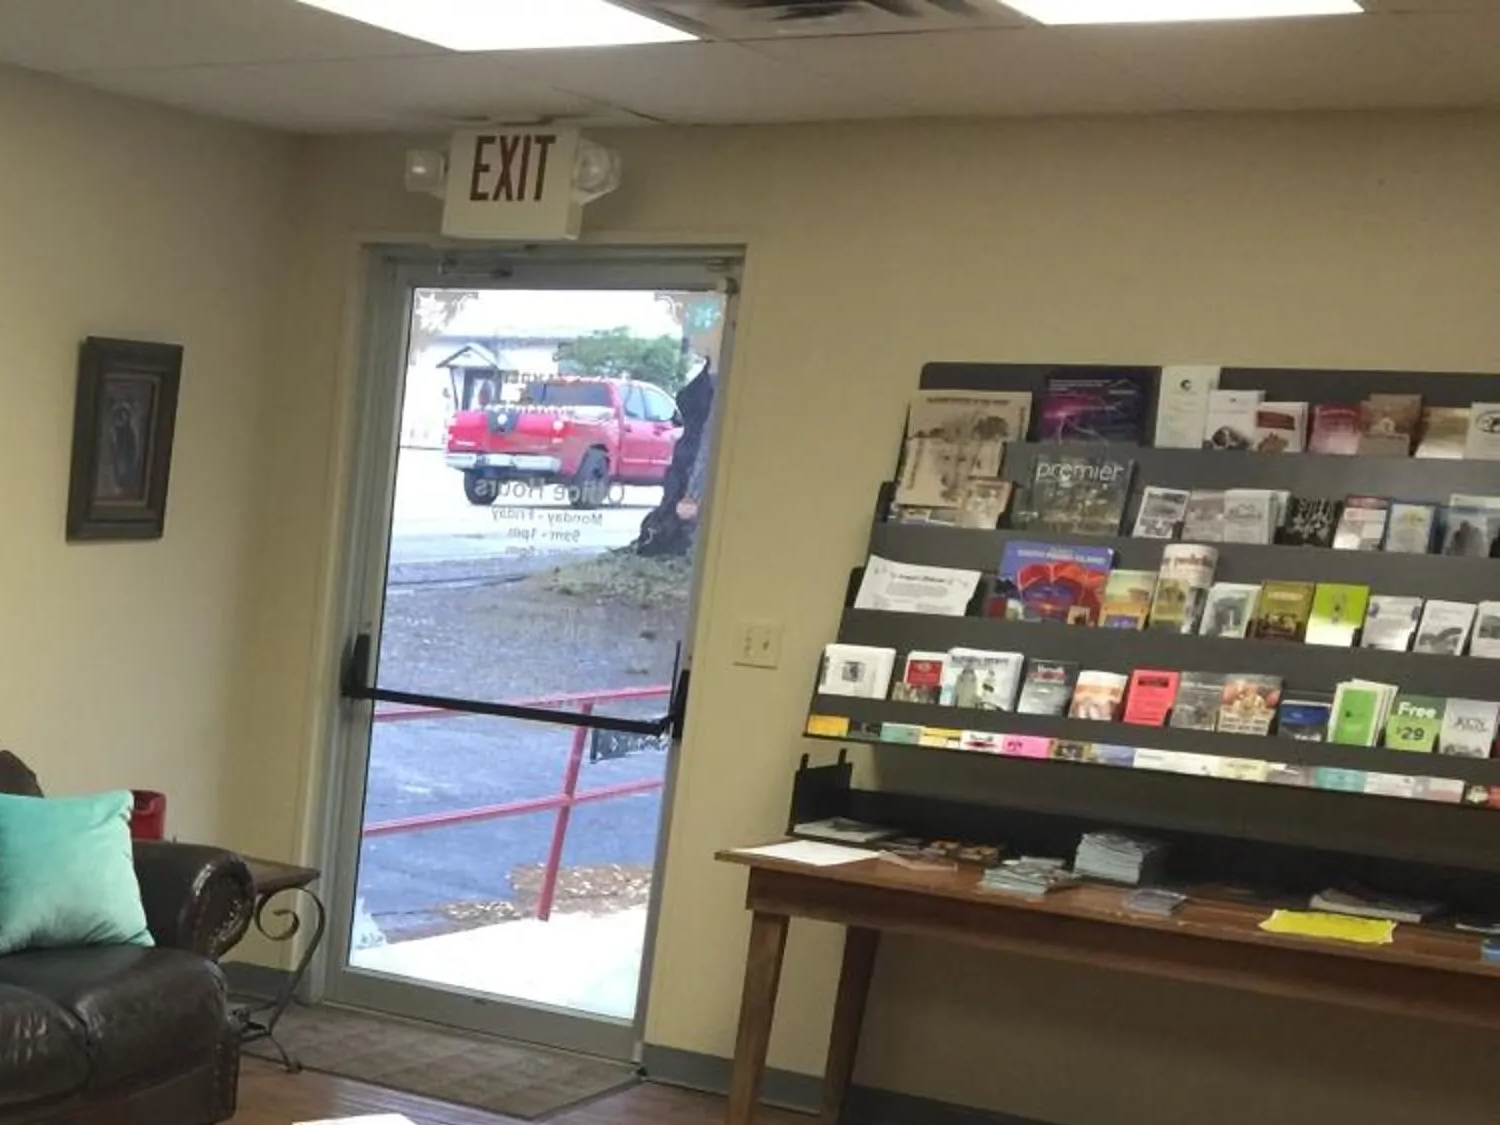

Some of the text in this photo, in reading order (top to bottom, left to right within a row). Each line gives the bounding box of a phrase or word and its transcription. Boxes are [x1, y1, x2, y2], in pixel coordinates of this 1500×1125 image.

[469, 134, 556, 202] EXIT
[1036, 463, 1124, 482] premier
[1398, 701, 1437, 719] Free
